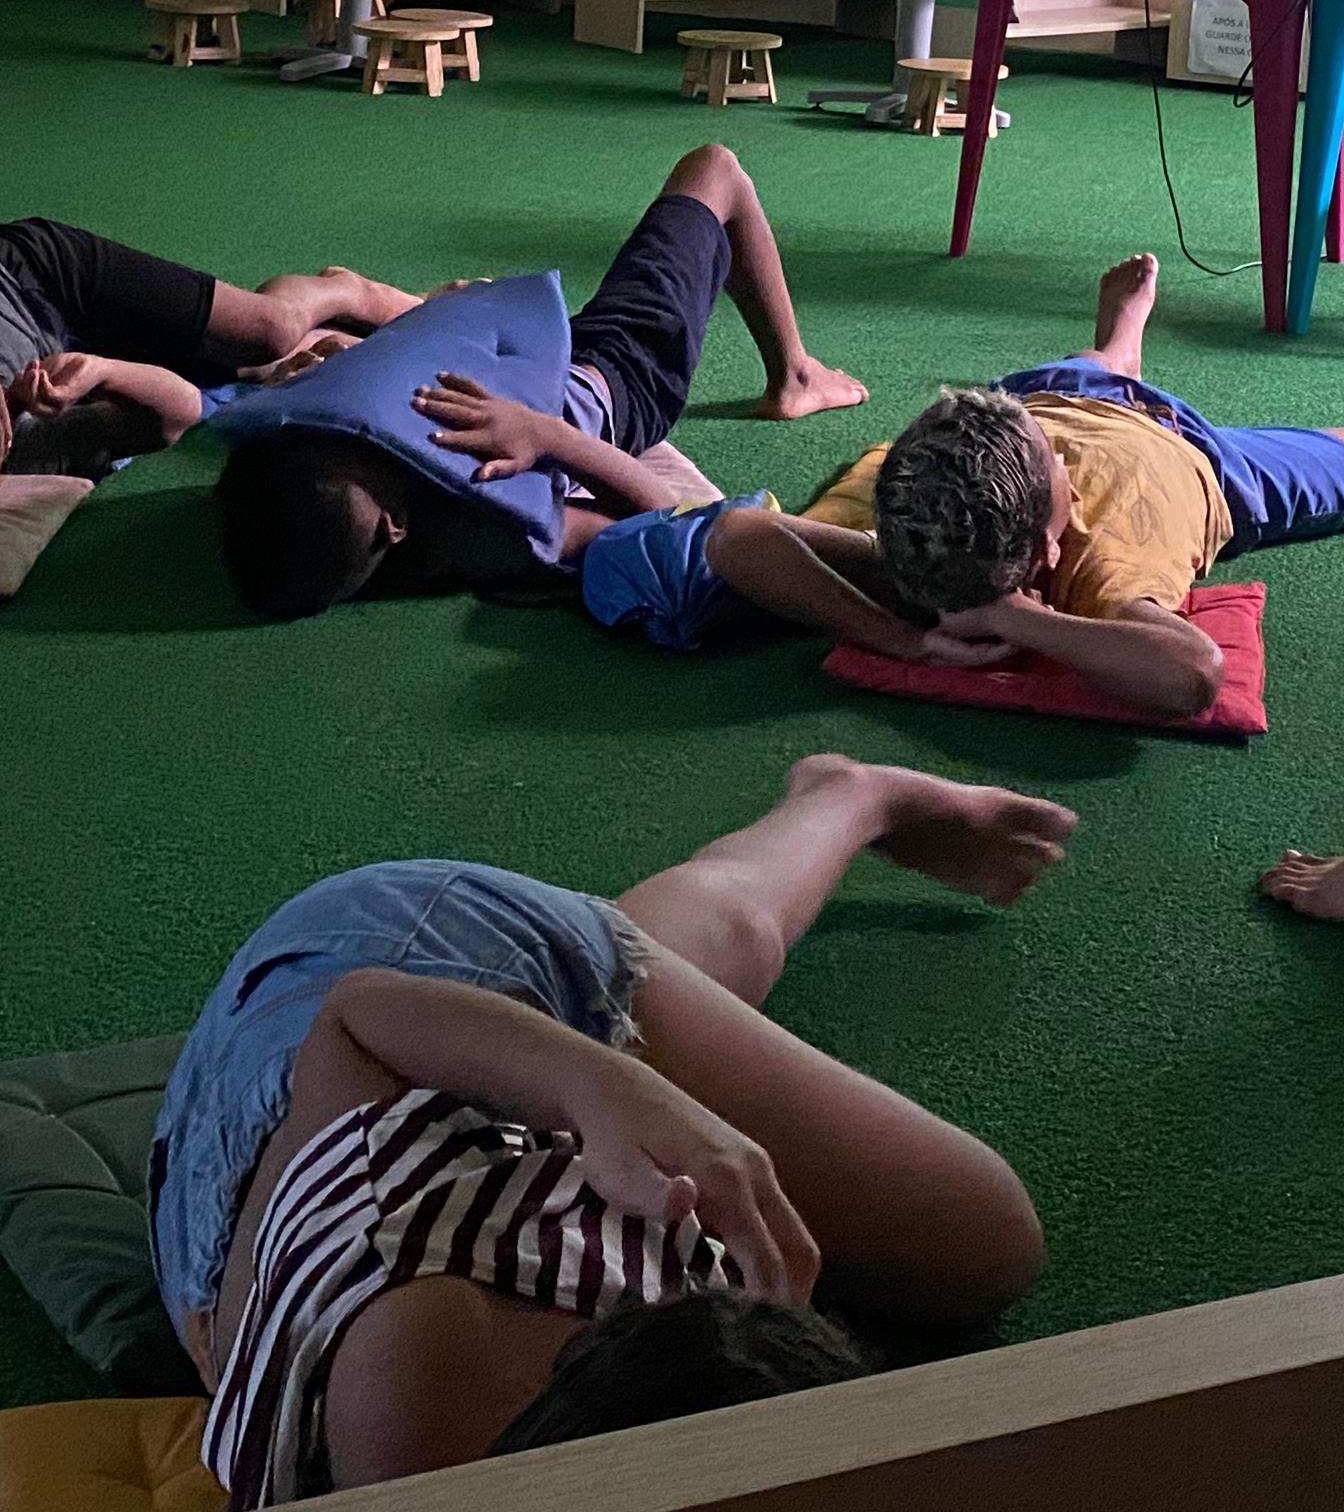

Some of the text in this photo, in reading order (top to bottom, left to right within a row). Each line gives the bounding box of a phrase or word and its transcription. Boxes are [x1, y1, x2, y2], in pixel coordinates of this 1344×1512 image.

[1212, 16, 1235, 28] APÓS
[1205, 30, 1242, 42] GUARDE
[1218, 45, 1245, 56] NESSA
